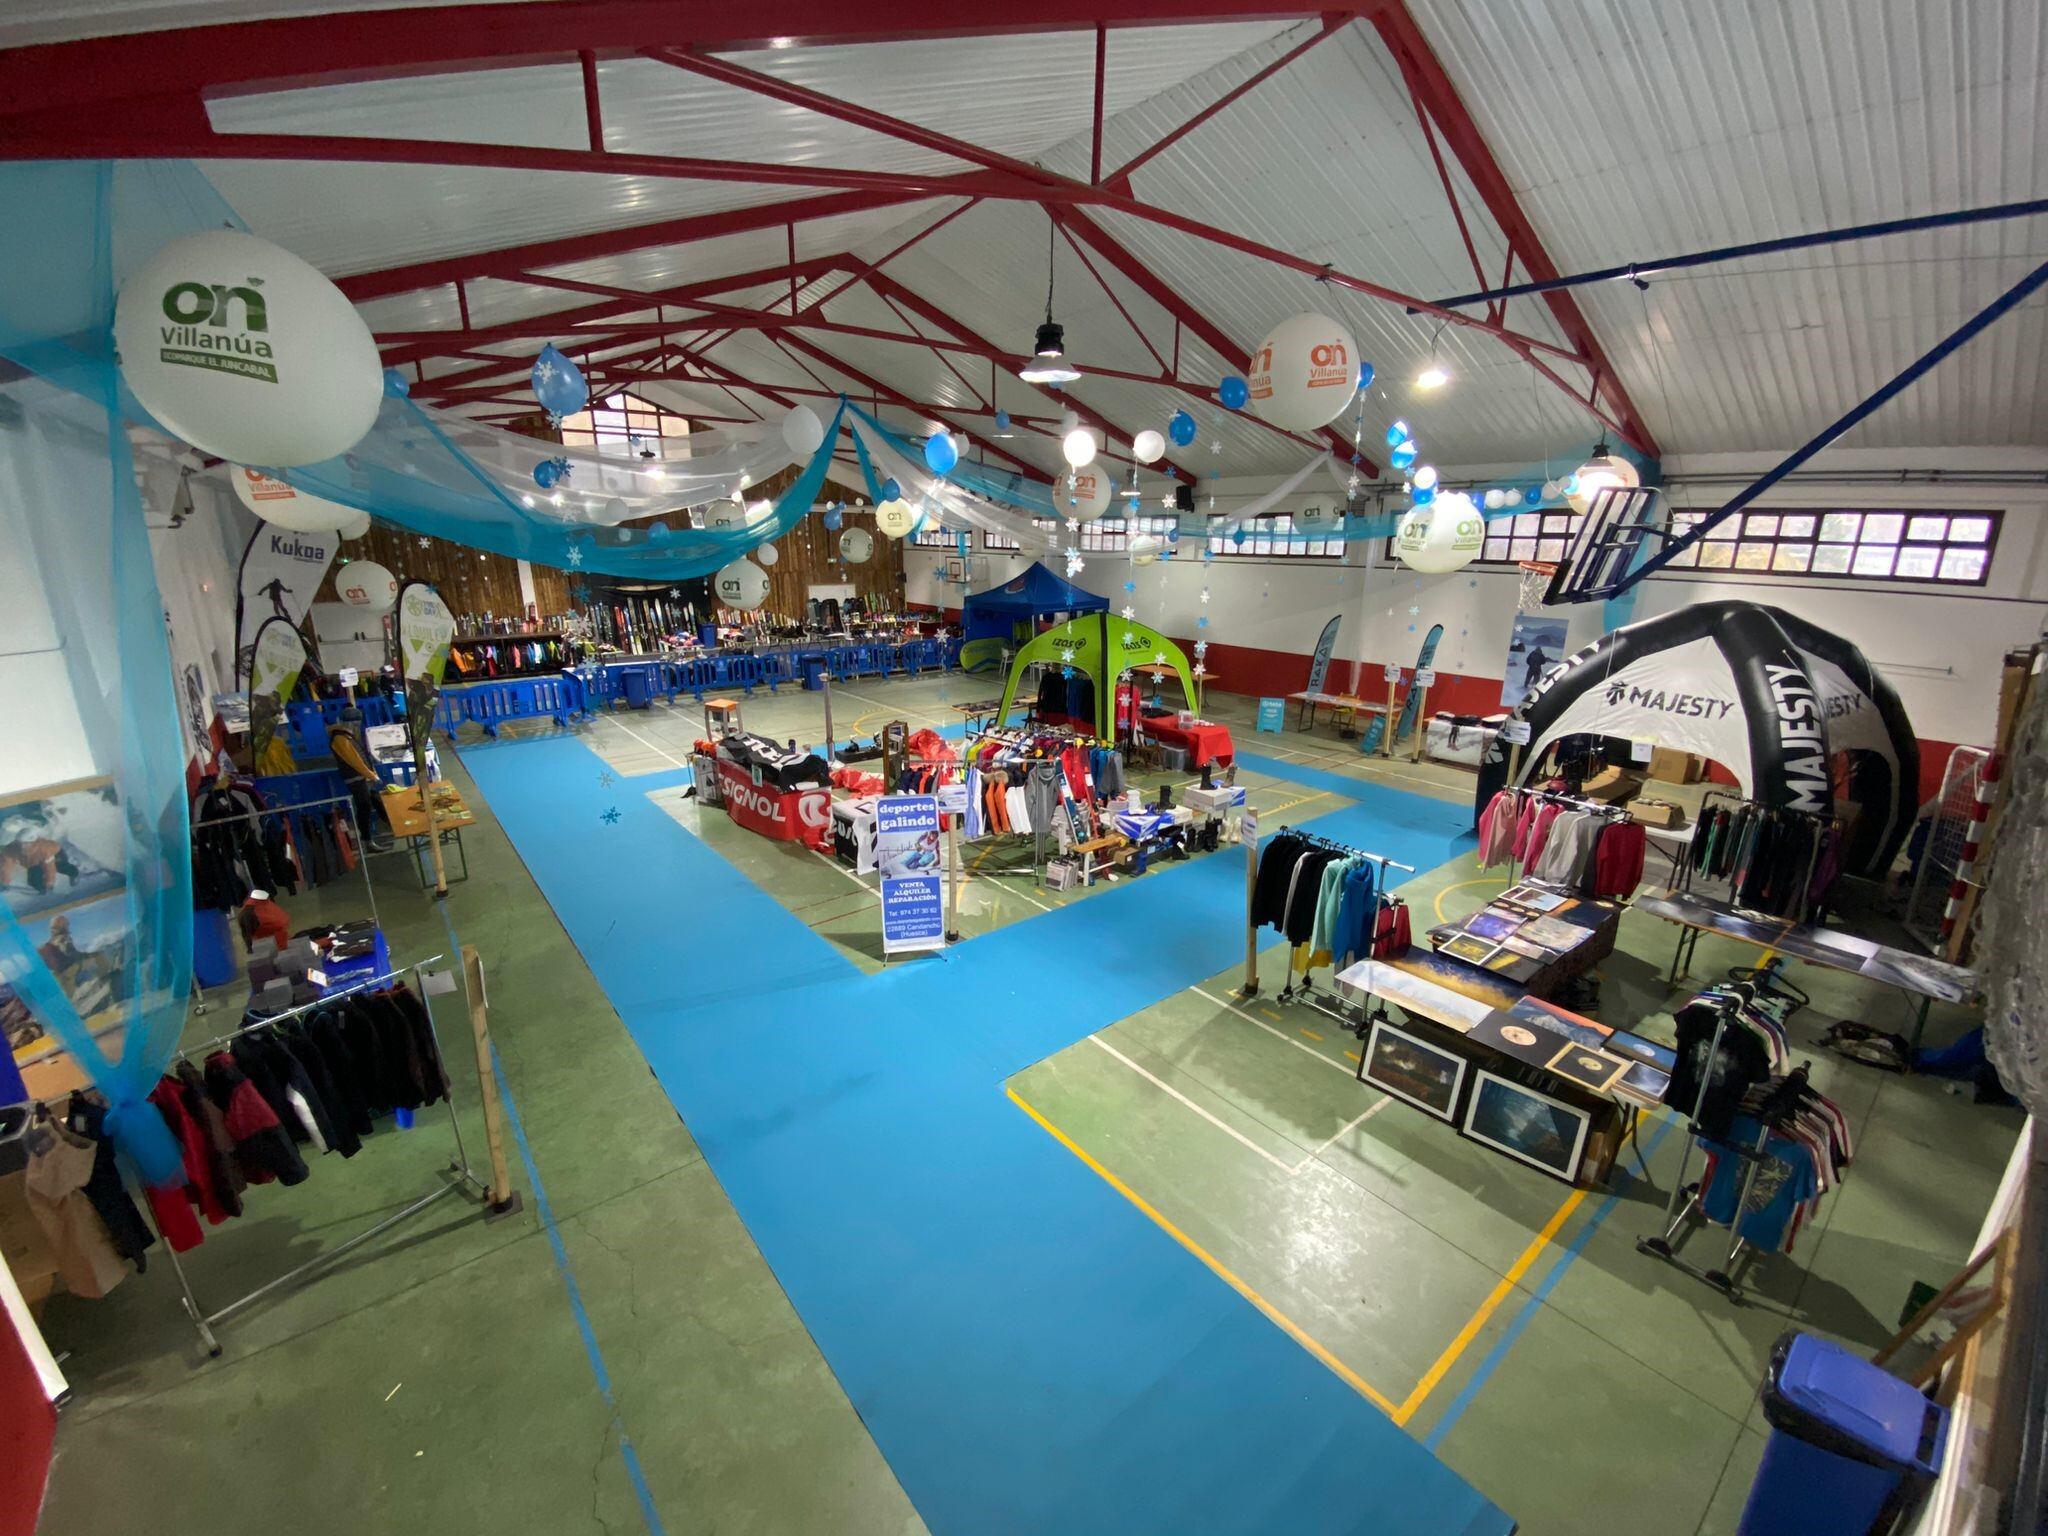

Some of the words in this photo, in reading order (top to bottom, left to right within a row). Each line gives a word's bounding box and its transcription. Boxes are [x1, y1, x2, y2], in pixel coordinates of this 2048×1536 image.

[163, 282, 268, 333] on
[161, 326, 273, 359] Villanúa
[1311, 344, 1347, 367] on
[1456, 520, 1482, 536] on
[271, 535, 325, 560] Kukoa
[722, 580, 740, 591] on
[1629, 686, 1735, 720] MAJESTY
[1766, 664, 1829, 813] MAJESTY
[879, 803, 935, 815] deportes
[880, 815, 936, 831] galindo
[888, 894, 937, 903] REPARACIÓN
[893, 888, 932, 896] ALQUILER
